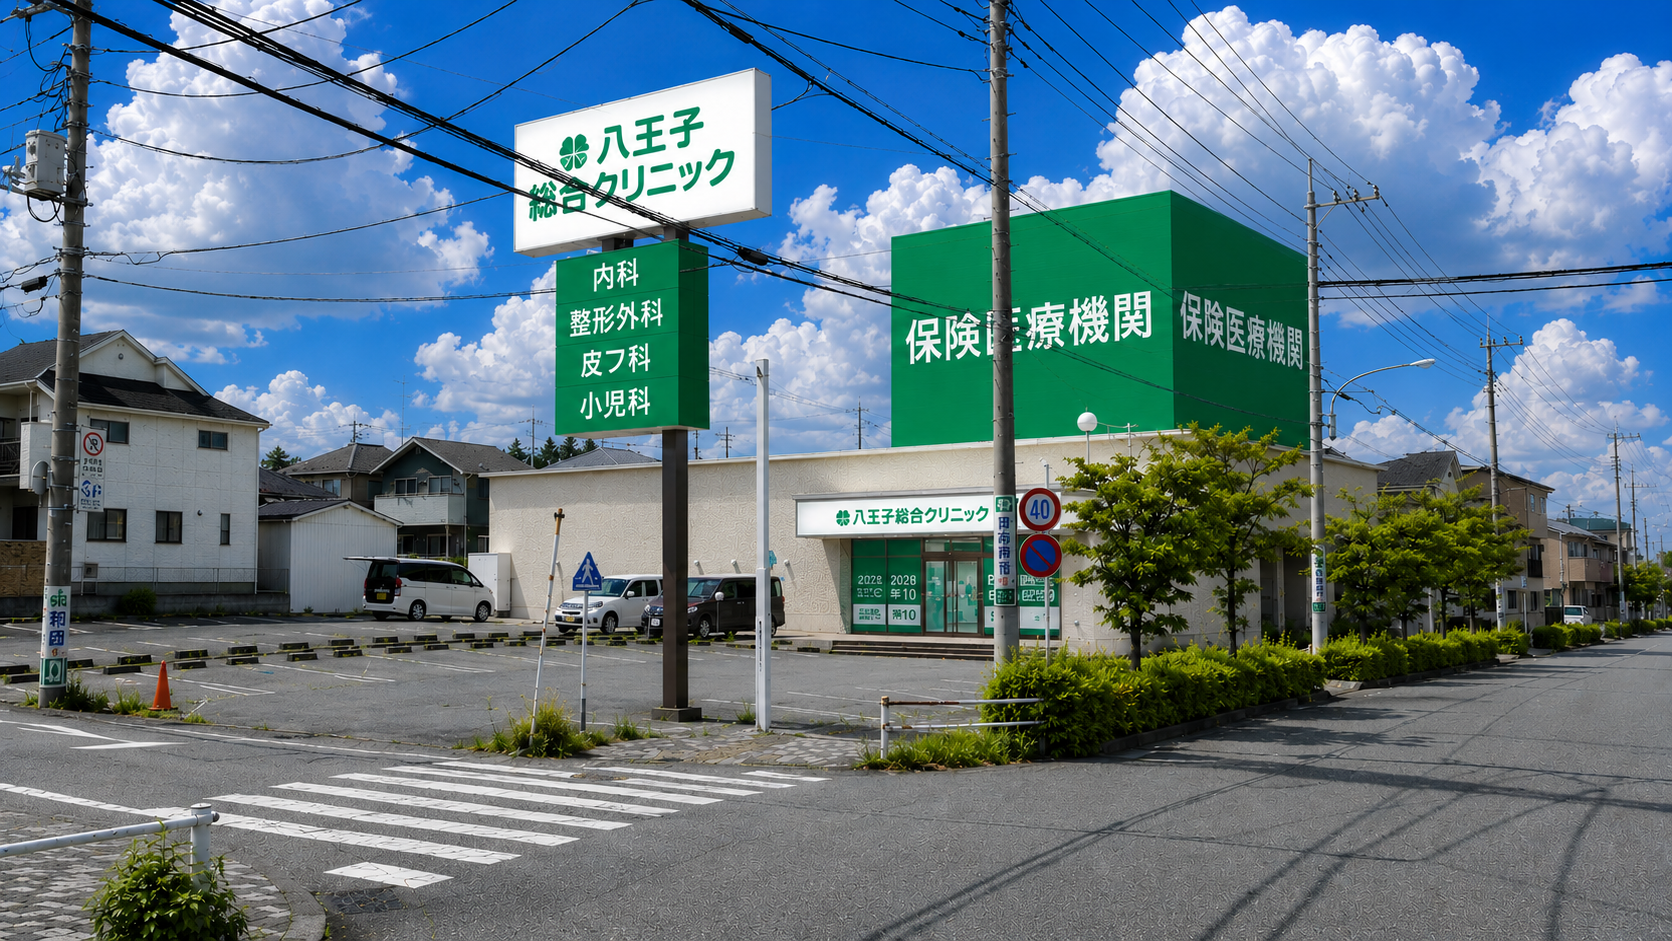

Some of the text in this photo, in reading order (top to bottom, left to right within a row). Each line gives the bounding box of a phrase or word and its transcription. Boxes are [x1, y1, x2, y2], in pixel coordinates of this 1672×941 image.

[597, 106, 705, 165] 八王子
[528, 148, 736, 222] 総合クリニック
[593, 258, 639, 292] 内科
[569, 298, 664, 338] 整形外科
[1180, 289, 1304, 370] 保険医療機関
[580, 343, 651, 379] 皮フ科
[579, 386, 651, 421] 小児科
[853, 505, 989, 526] 八王子総合クリニック
[1030, 499, 1050, 520] 40
[890, 575, 917, 586] 2028
